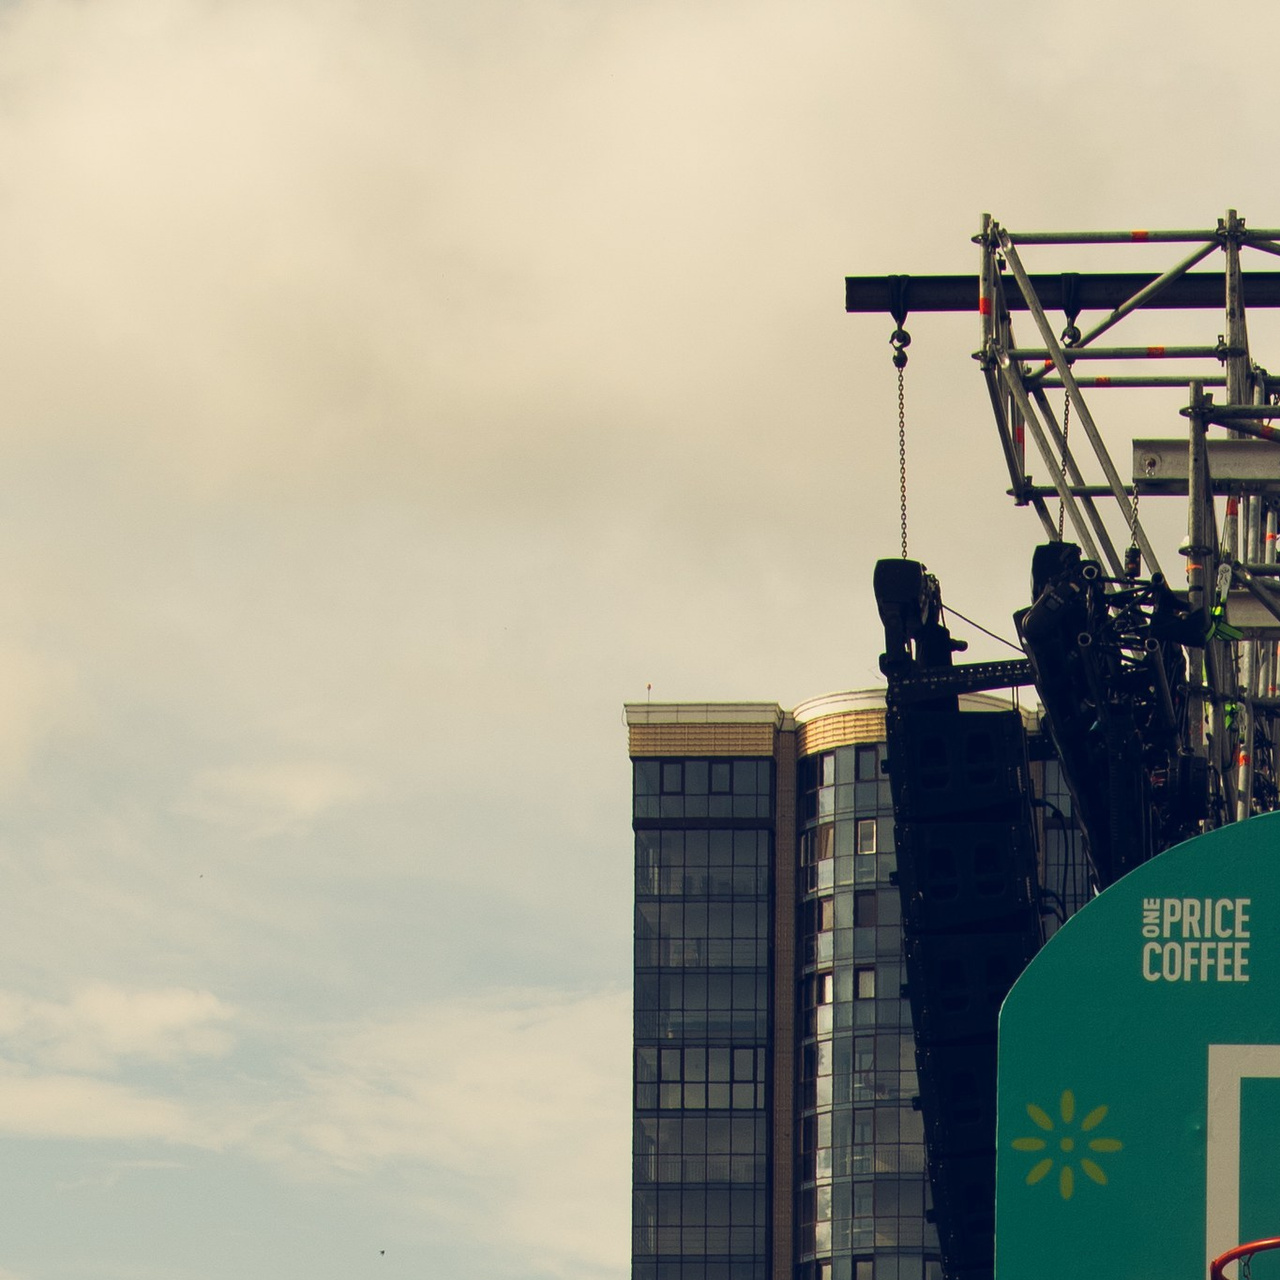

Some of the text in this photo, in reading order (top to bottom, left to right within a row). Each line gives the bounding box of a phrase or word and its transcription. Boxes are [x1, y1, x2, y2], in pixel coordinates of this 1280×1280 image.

[1141, 898, 1251, 938] ONE PRICE
[1142, 941, 1250, 982] COFFEE
